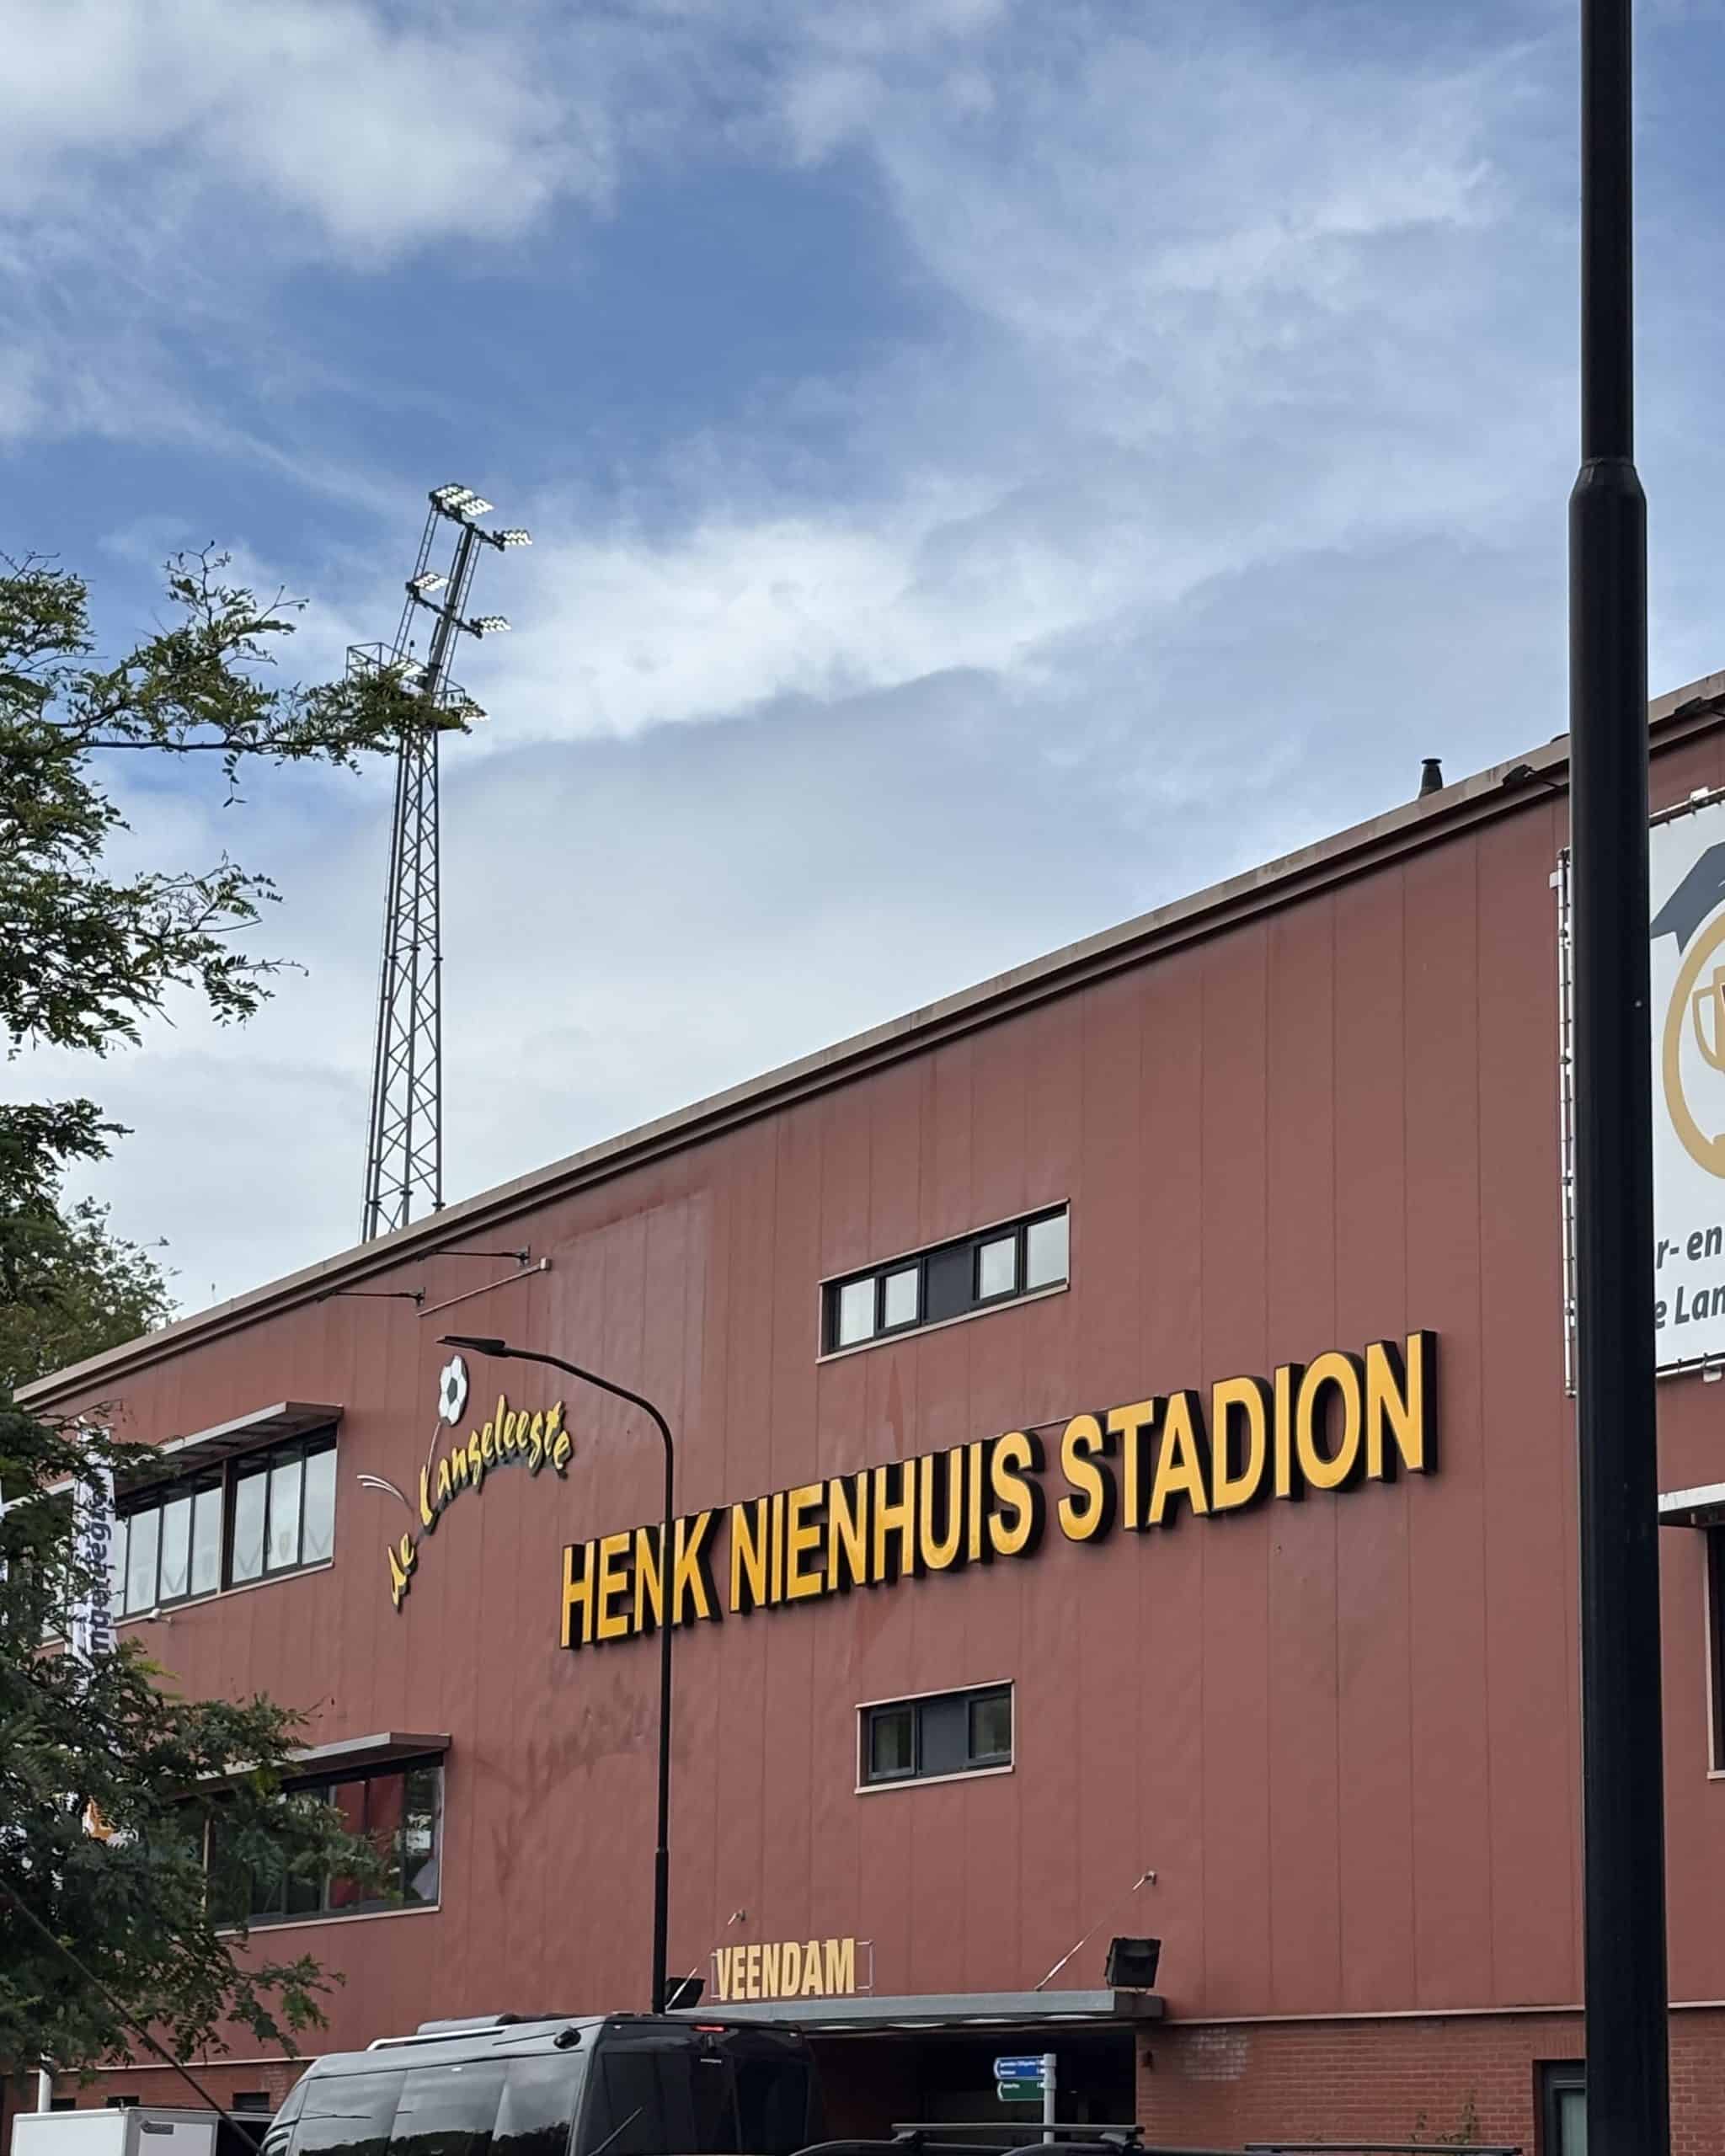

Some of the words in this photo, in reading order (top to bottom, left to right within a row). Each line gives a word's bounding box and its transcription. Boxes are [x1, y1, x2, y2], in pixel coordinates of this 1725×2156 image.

[1656, 1238, 1680, 1269] r-
[1687, 1225, 1722, 1261] en
[1655, 1299, 1668, 1330] e
[559, 1508, 719, 1649] HENK
[729, 1430, 1041, 1614] NIENHUIS
[1057, 1331, 1434, 1543] STADION
[716, 1938, 856, 2002] VEENDAM
